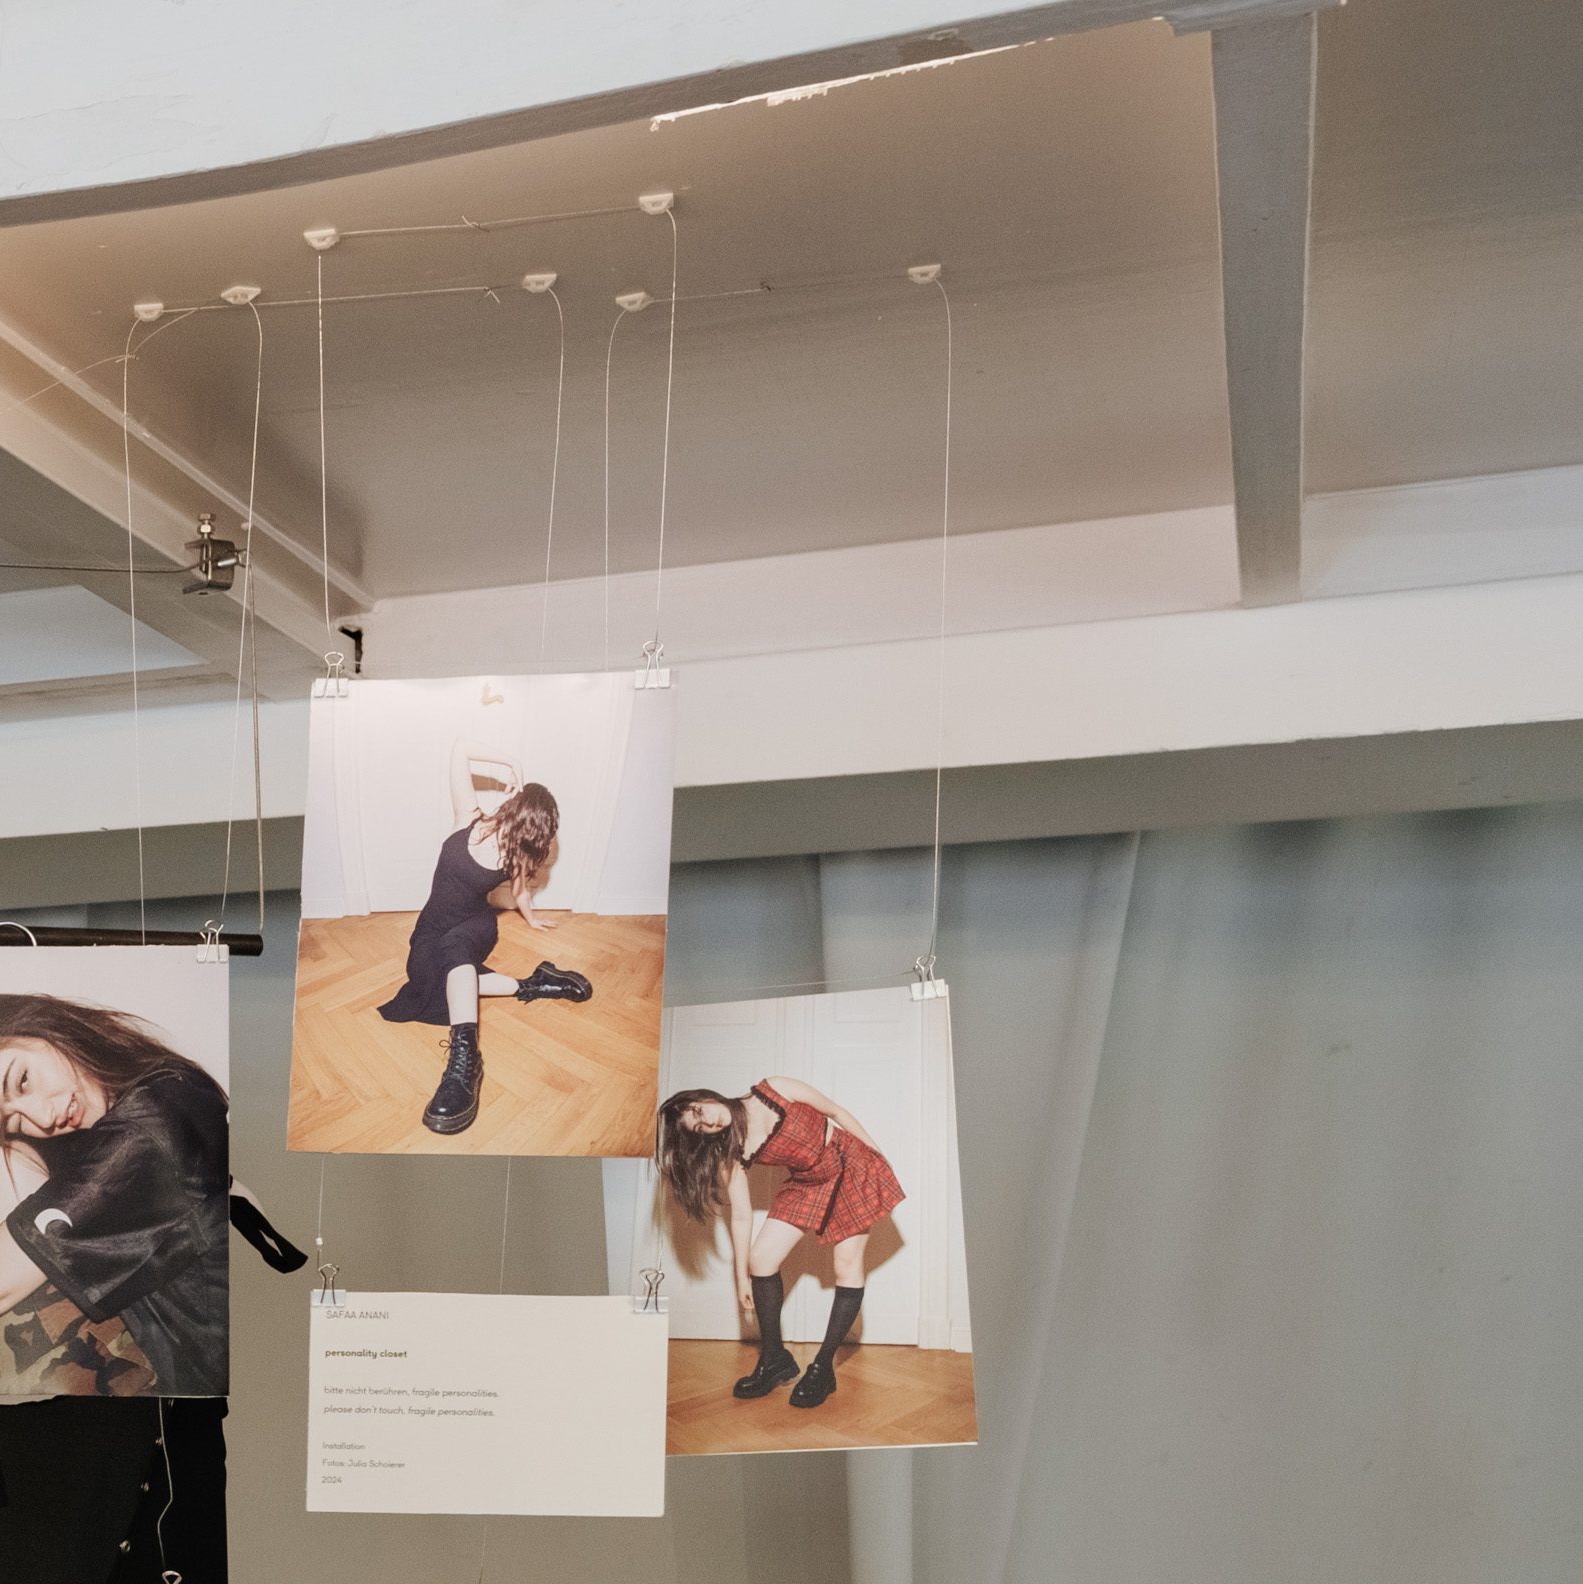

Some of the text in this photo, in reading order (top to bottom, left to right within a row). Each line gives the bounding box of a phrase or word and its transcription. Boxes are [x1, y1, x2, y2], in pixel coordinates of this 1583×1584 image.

[325, 1310, 390, 1320] SAFAA ANANI
[325, 1349, 408, 1359] personality closet
[324, 1386, 500, 1398] bitte nicht berühren, fragile personalities.
[323, 1405, 353, 1414] please
[379, 1406, 406, 1415] touch,
[407, 1406, 436, 1417] fragile
[437, 1408, 496, 1417] personalities.
[322, 1442, 366, 1450] Installation
[321, 1476, 343, 1484] 2024
